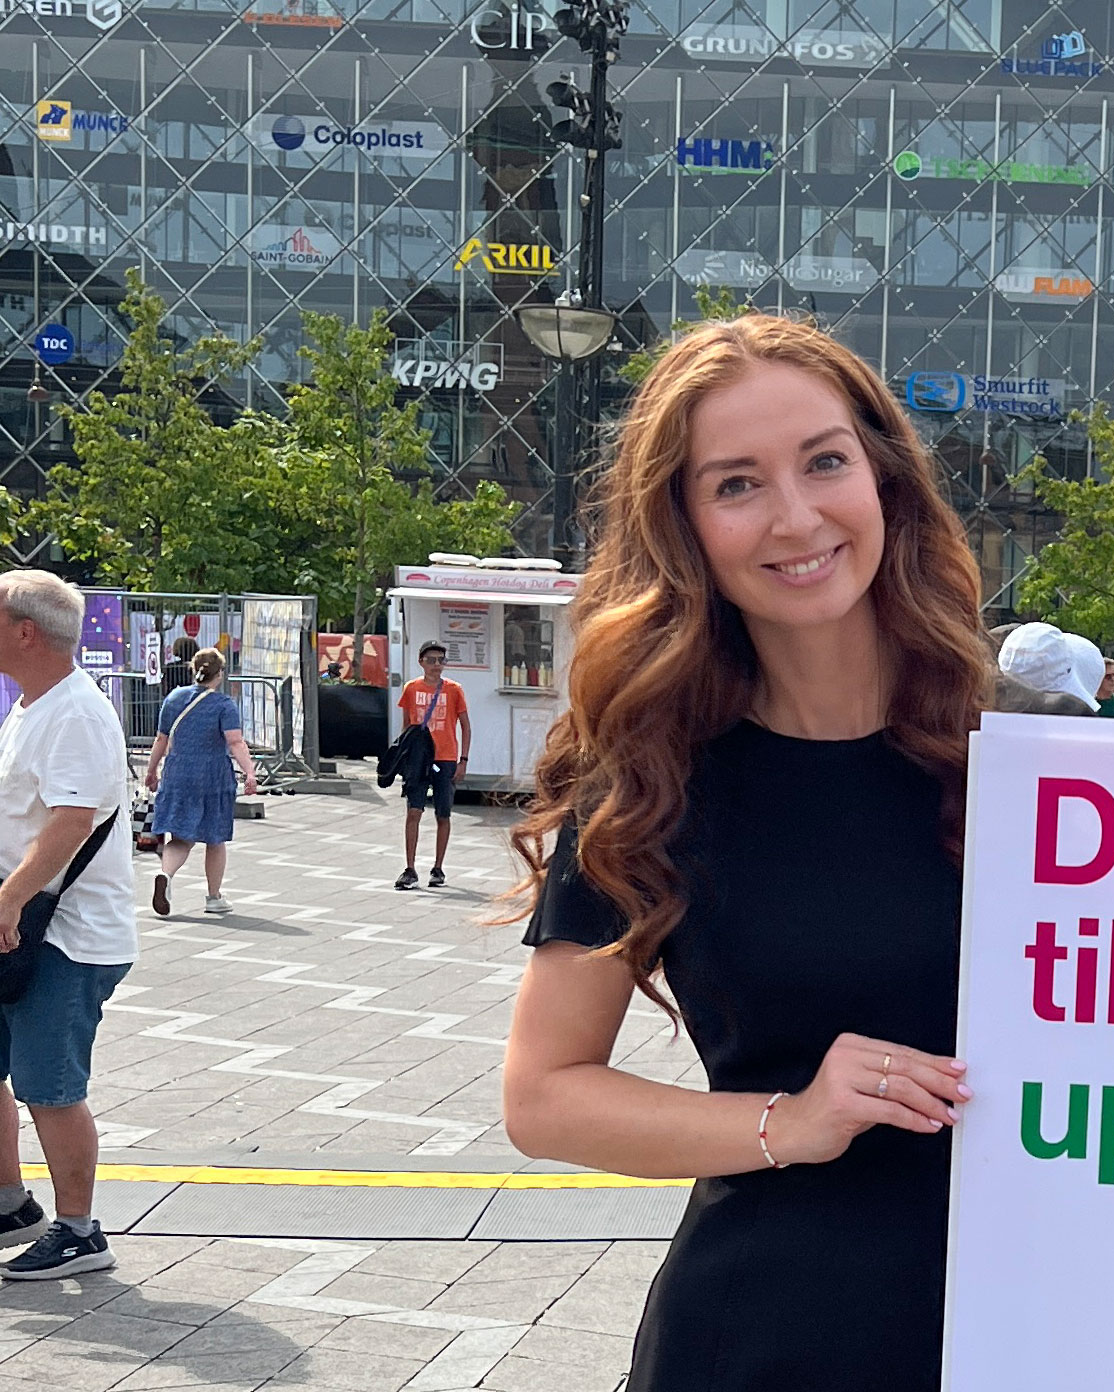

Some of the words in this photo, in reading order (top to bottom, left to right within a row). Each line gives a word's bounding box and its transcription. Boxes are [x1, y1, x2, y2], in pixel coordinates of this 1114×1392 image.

[313, 125, 423, 150] Coloplast
[678, 138, 762, 168] HHM
[250, 251, 334, 266] SAINT-GOBAIN
[454, 238, 559, 274] ARKIL
[806, 262, 863, 287] Sugar
[42, 337, 68, 351] TDC
[391, 359, 500, 391] KPMG
[974, 374, 1050, 396] Smurfit
[973, 393, 1064, 418] Westrock
[433, 574, 490, 588] Copenhagen
[491, 576, 527, 589] Hotdog
